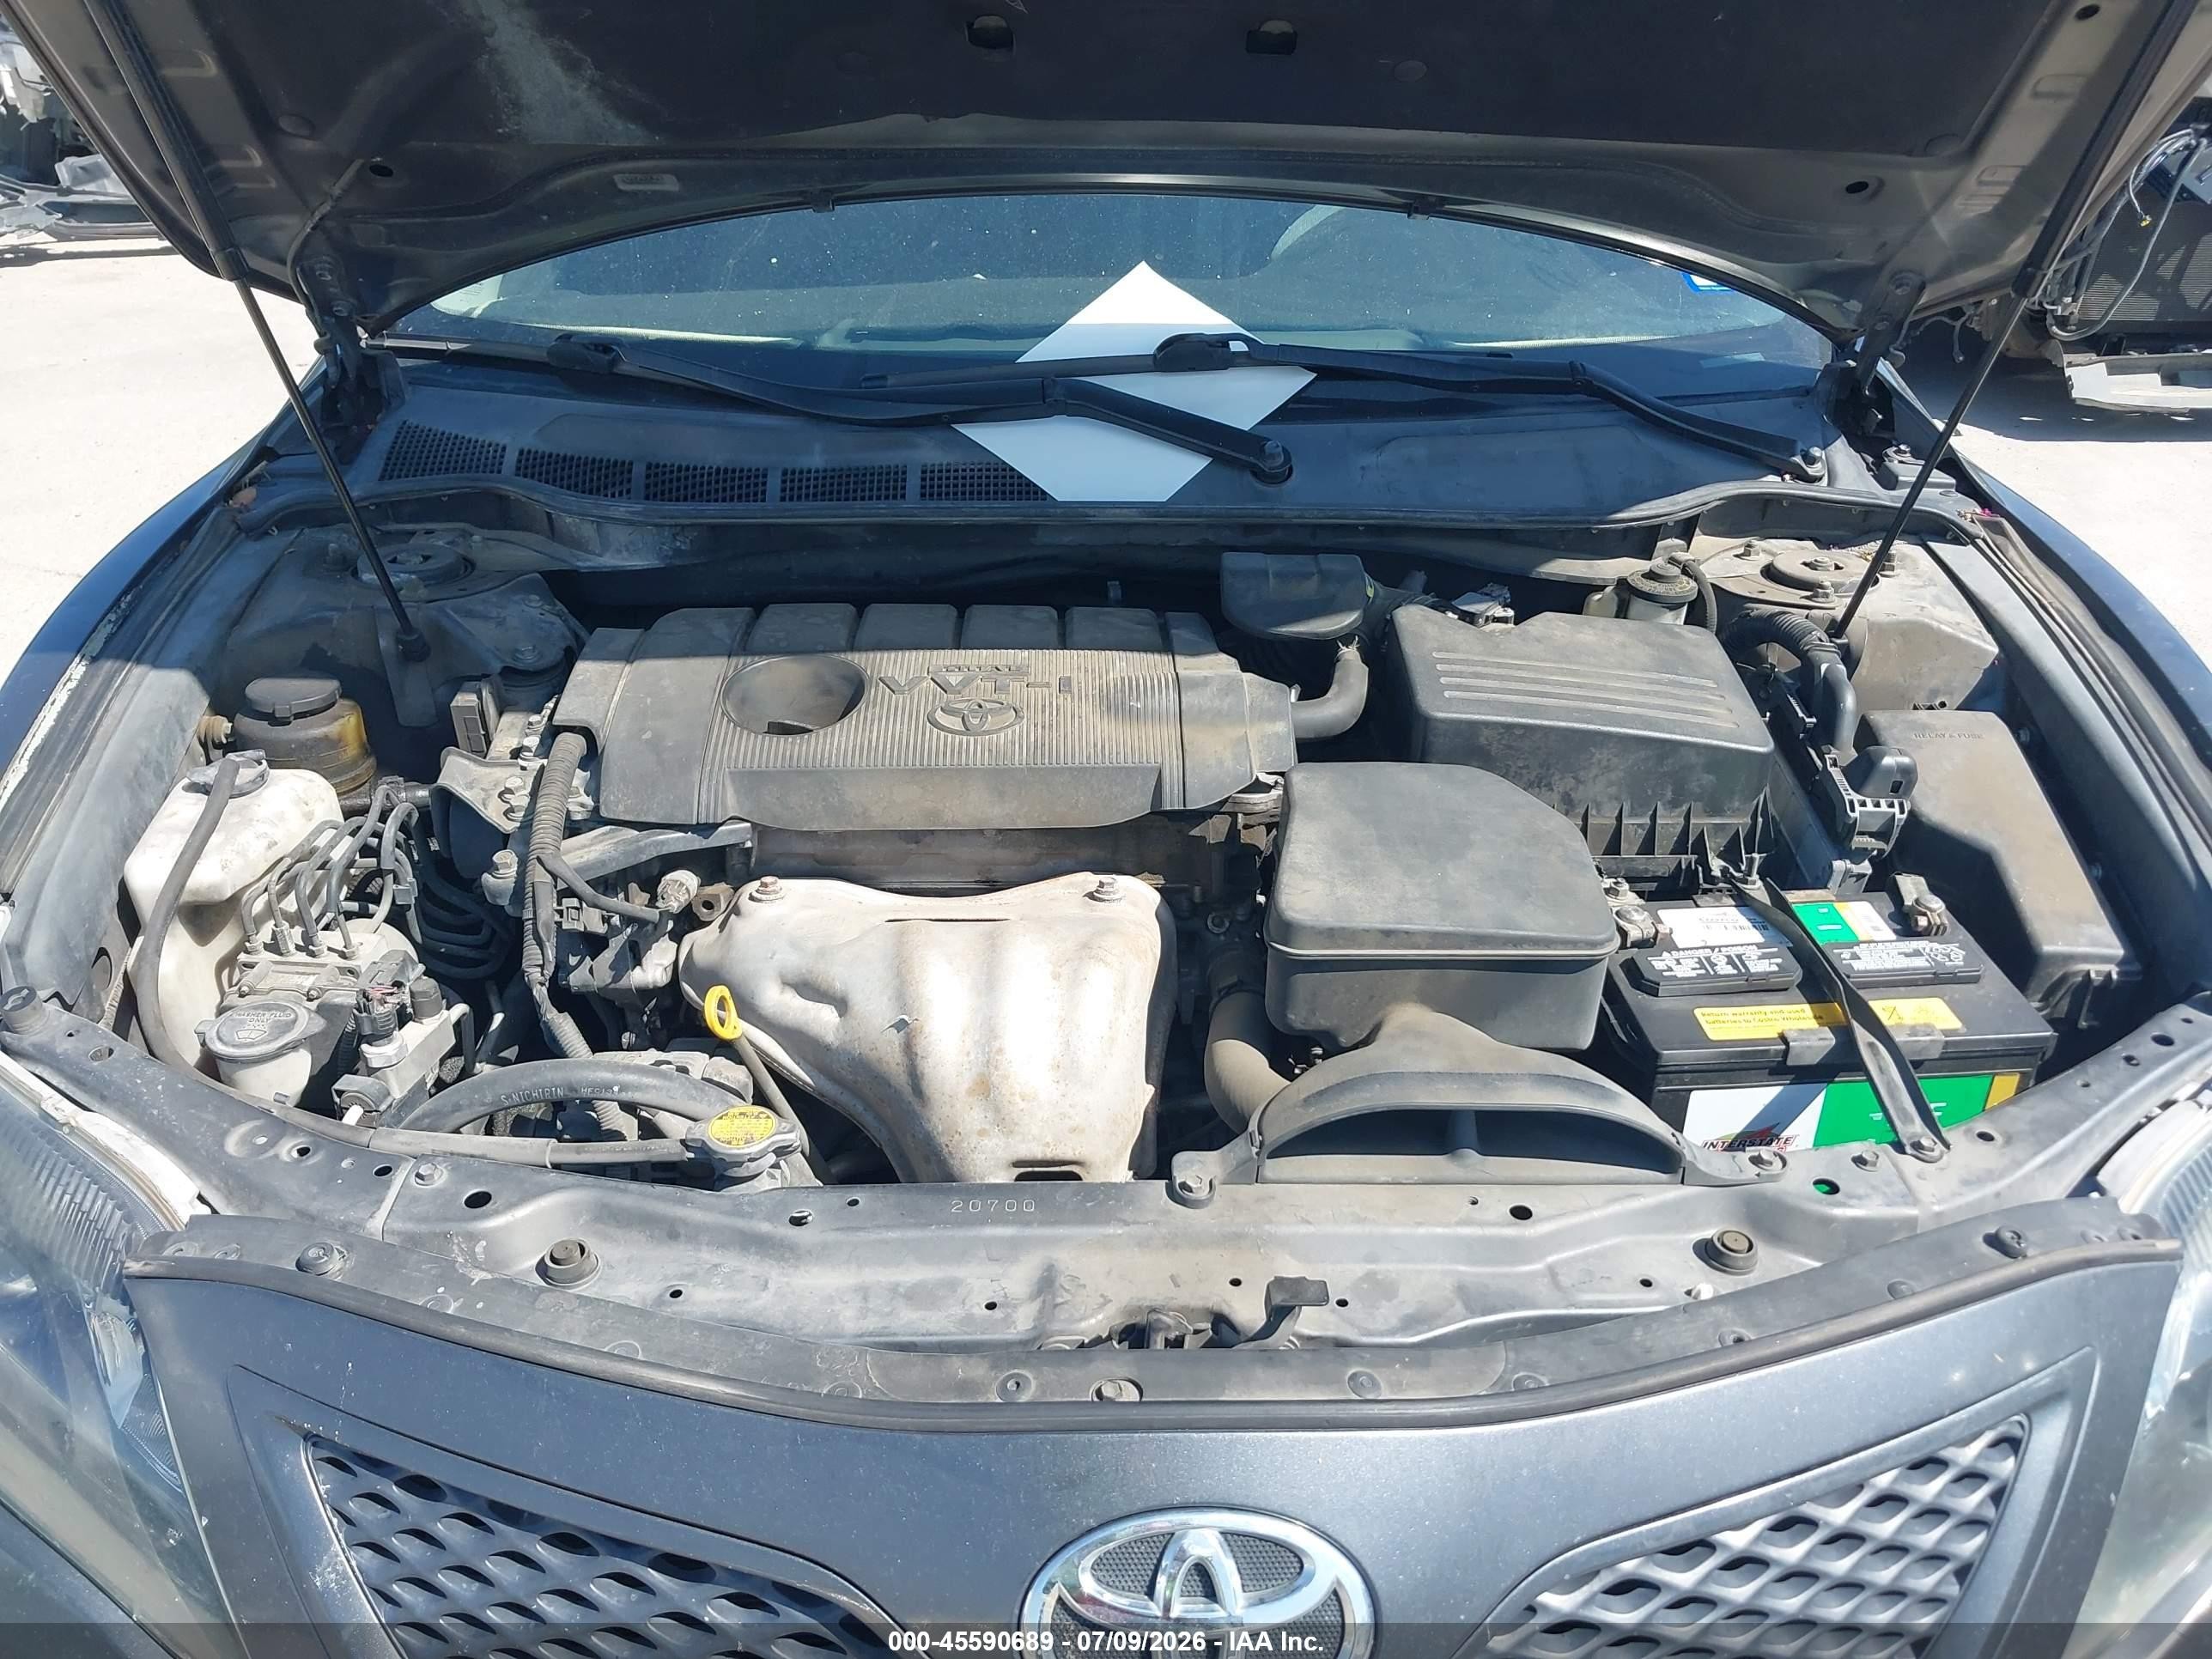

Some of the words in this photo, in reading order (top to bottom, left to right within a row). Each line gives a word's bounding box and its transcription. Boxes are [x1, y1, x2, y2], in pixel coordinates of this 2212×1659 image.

[1670, 948, 1712, 957] DANGER
[1720, 944, 1758, 953] POISON
[1703, 1136, 1794, 1150] INTERSTATE
[951, 1199, 1036, 1212] 20700
